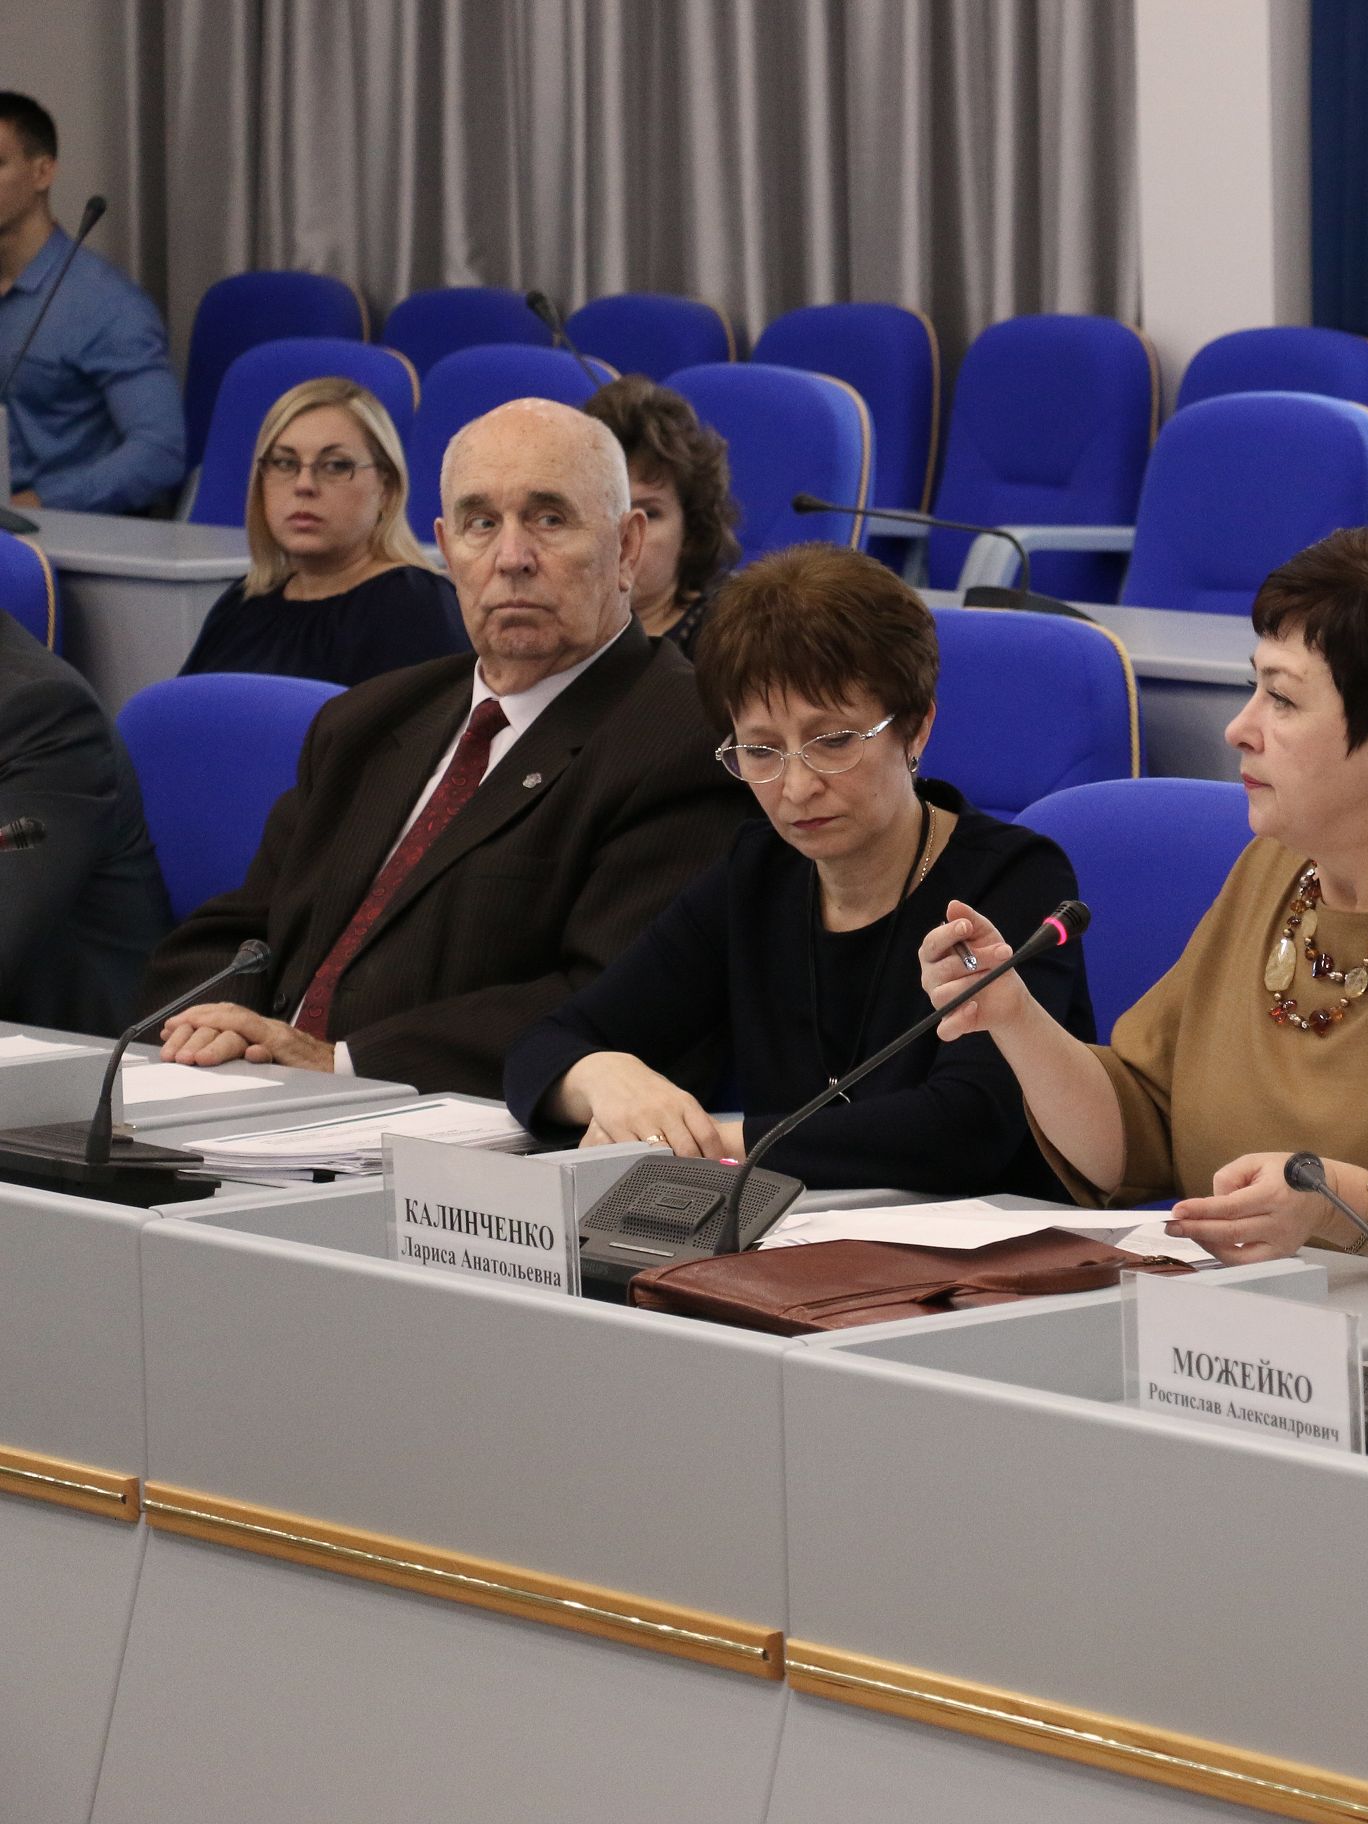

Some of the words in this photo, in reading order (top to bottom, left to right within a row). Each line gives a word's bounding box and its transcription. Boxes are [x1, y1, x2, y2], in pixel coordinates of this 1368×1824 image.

[404, 1198, 555, 1251] КАЛИНЧЕНКО
[401, 1236, 456, 1266] Лариса
[461, 1249, 562, 1288] Анатольевна
[1172, 1347, 1313, 1404] МОЖЕЙКО
[1149, 1382, 1222, 1415] Ростислав
[1226, 1401, 1339, 1442] Александрович
